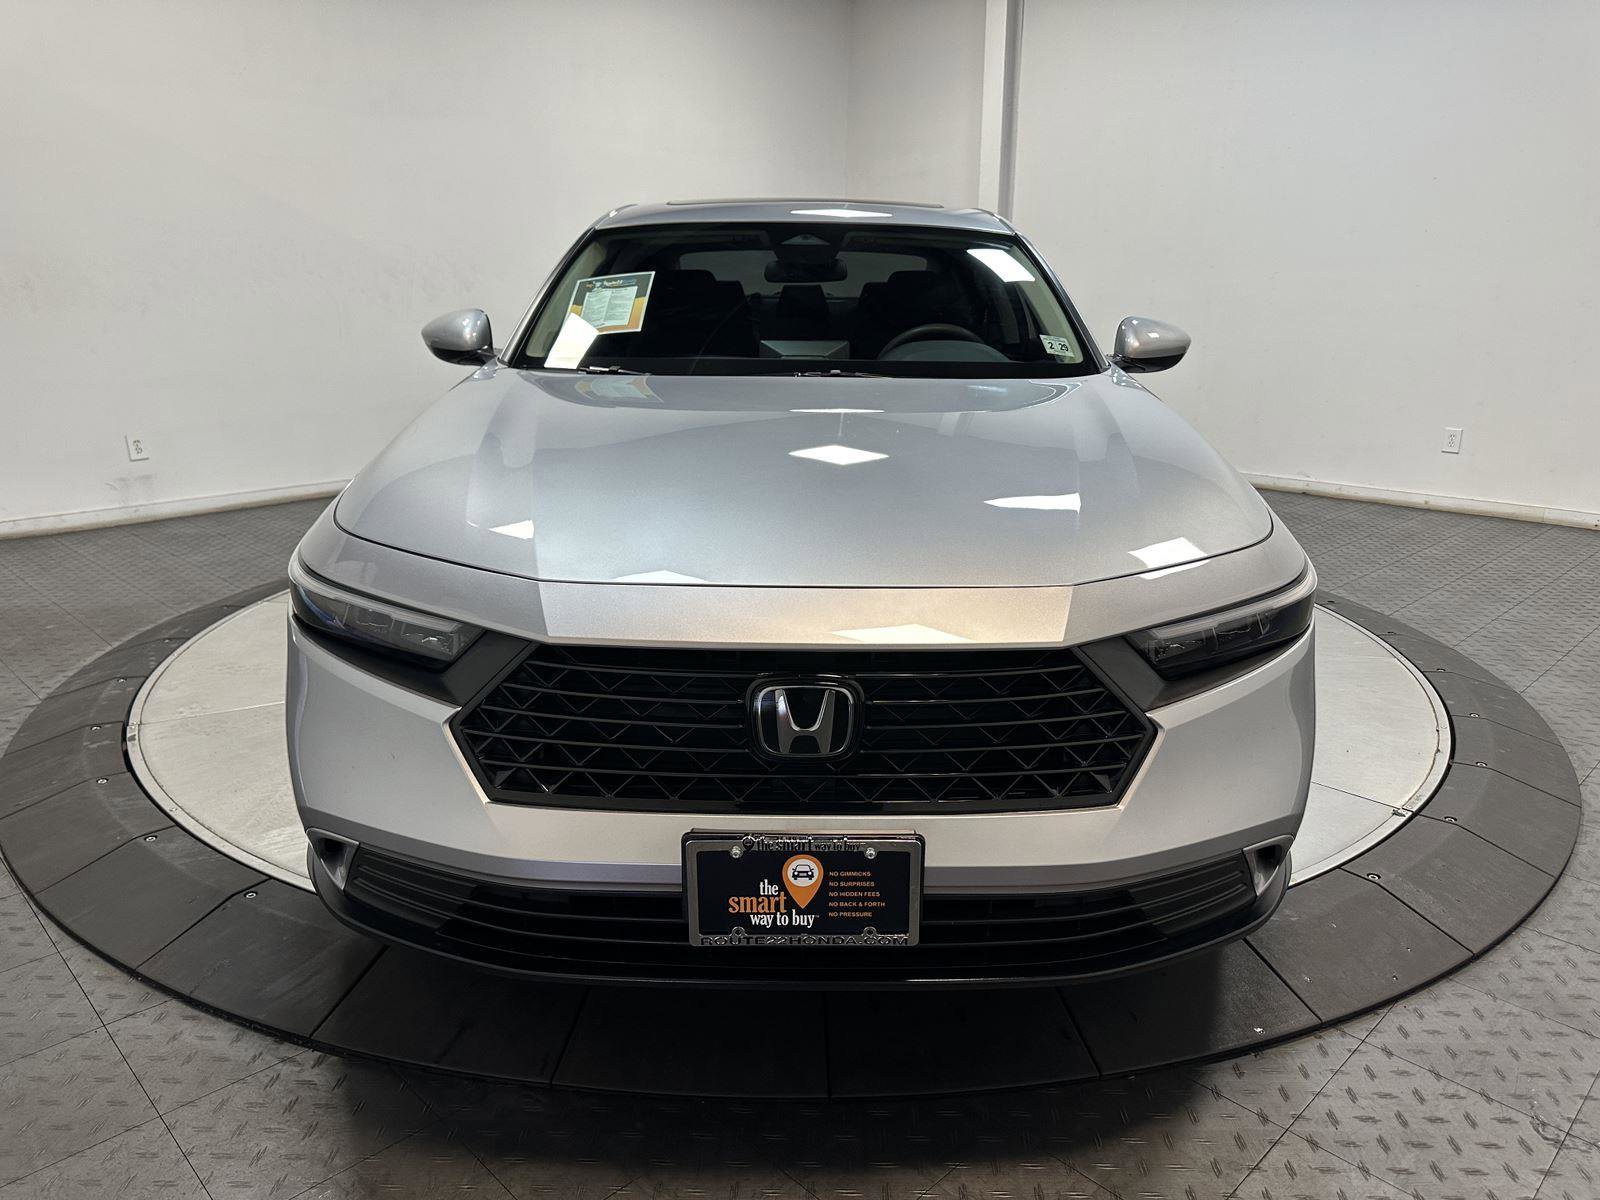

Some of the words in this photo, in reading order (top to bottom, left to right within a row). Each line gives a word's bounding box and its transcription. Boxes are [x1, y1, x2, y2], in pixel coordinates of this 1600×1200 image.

[1048, 342, 1054, 350] 2
[757, 837, 775, 851] the
[775, 837, 814, 851] smart
[815, 842, 833, 852] way
[844, 837, 862, 852] buy
[759, 878, 779, 895] the
[728, 891, 787, 913] smart
[750, 914, 775, 928] way
[776, 911, 789, 926] to
[700, 935, 909, 946] ROUTE22HONDA.COM
